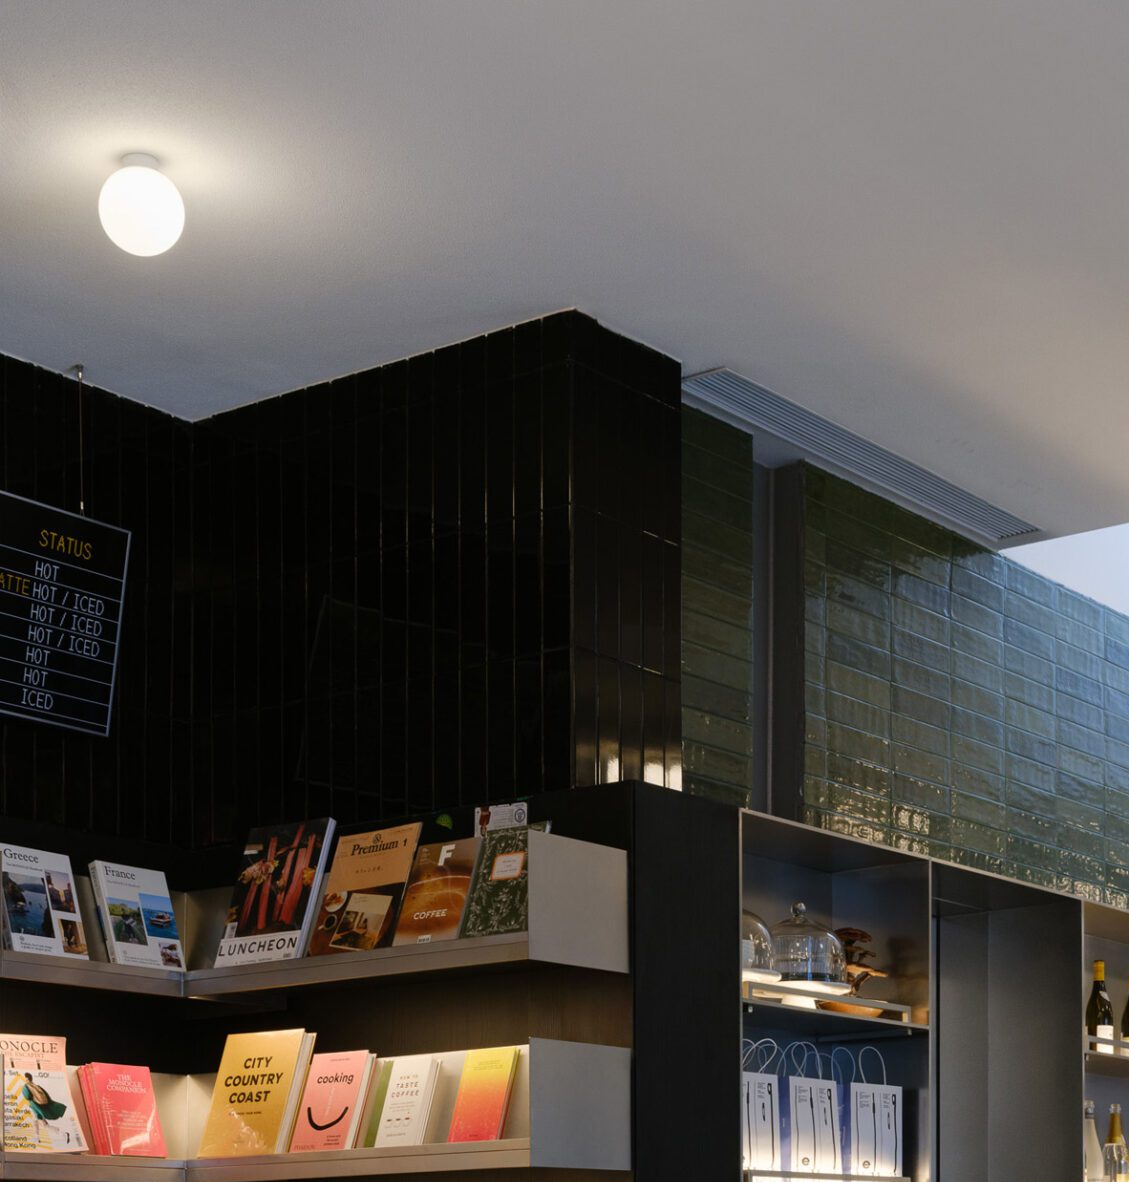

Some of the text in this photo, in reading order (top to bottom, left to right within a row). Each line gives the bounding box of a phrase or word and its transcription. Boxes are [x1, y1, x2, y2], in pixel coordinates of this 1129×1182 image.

[38, 529, 93, 561] STATUS
[34, 561, 60, 582] HOT
[32, 583, 105, 616] HOT / ICED
[30, 604, 103, 637] HOT / ICED
[28, 625, 101, 658] HOT / ICED
[25, 646, 51, 666] HOT
[23, 668, 49, 687] HOT
[21, 688, 54, 711] ICED
[3, 847, 40, 864] Greece
[351, 839, 399, 857] Premium
[437, 844, 456, 867] F
[103, 865, 137, 881] France
[413, 908, 449, 921] COFFEE
[218, 936, 298, 958] LUNCHEON
[244, 1056, 273, 1069] CITY
[224, 1072, 284, 1087] COUNTRY
[317, 1072, 354, 1085] cooking
[229, 1091, 271, 1104] COAST
[391, 1090, 420, 1098] COFFEE
